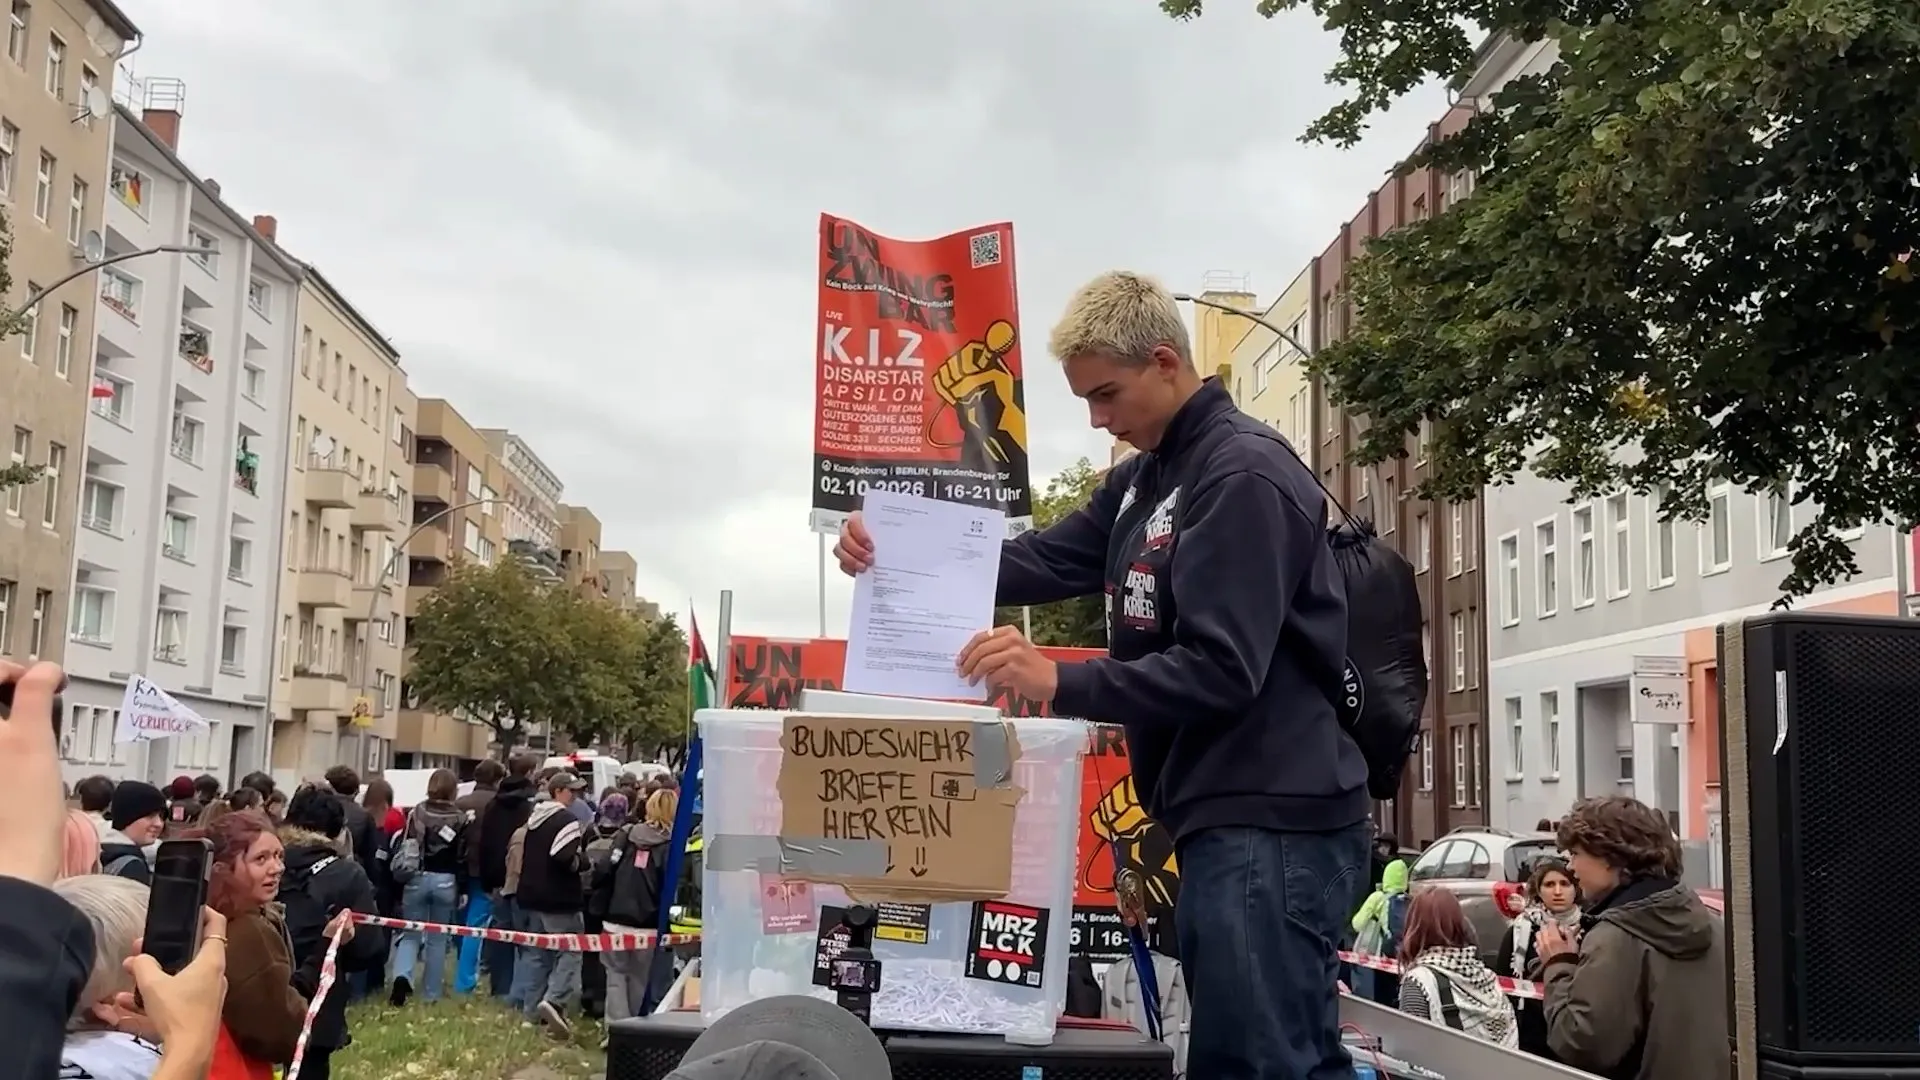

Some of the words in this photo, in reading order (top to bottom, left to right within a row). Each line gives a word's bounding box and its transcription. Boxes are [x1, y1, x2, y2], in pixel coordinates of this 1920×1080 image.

[827, 220, 880, 260] UN
[825, 250, 955, 301] ZWING
[826, 279, 842, 288] Kein
[842, 282, 863, 290] Bock
[826, 310, 843, 321] LIVE
[880, 289, 957, 333] BAR
[823, 323, 925, 367] K.I.Z
[823, 365, 924, 385] DISARSTAR
[823, 386, 924, 402] APSILON
[823, 398, 850, 410] DRITTE
[852, 403, 878, 413] WAHL
[822, 409, 897, 424] GUTERZOGENE
[822, 431, 850, 442] GOLDIE
[878, 435, 922, 444] SECHSER
[833, 463, 888, 476] Kundgebung
[895, 466, 930, 477] BERLIN,
[933, 467, 995, 481] Brandenburger
[997, 472, 1011, 480] Tor
[820, 476, 925, 497] 02.102026
[944, 484, 991, 500] 16-21
[995, 487, 1022, 502] Uhr
[1124, 595, 1156, 620] KRIEG
[735, 644, 802, 678] UN
[791, 725, 975, 762] BUNDESWEHR
[817, 768, 918, 804] BRIEFE
[823, 807, 885, 840] HIER
[885, 801, 952, 839] REIN
[982, 911, 1038, 937] MRZ
[980, 930, 1034, 956] LCK
